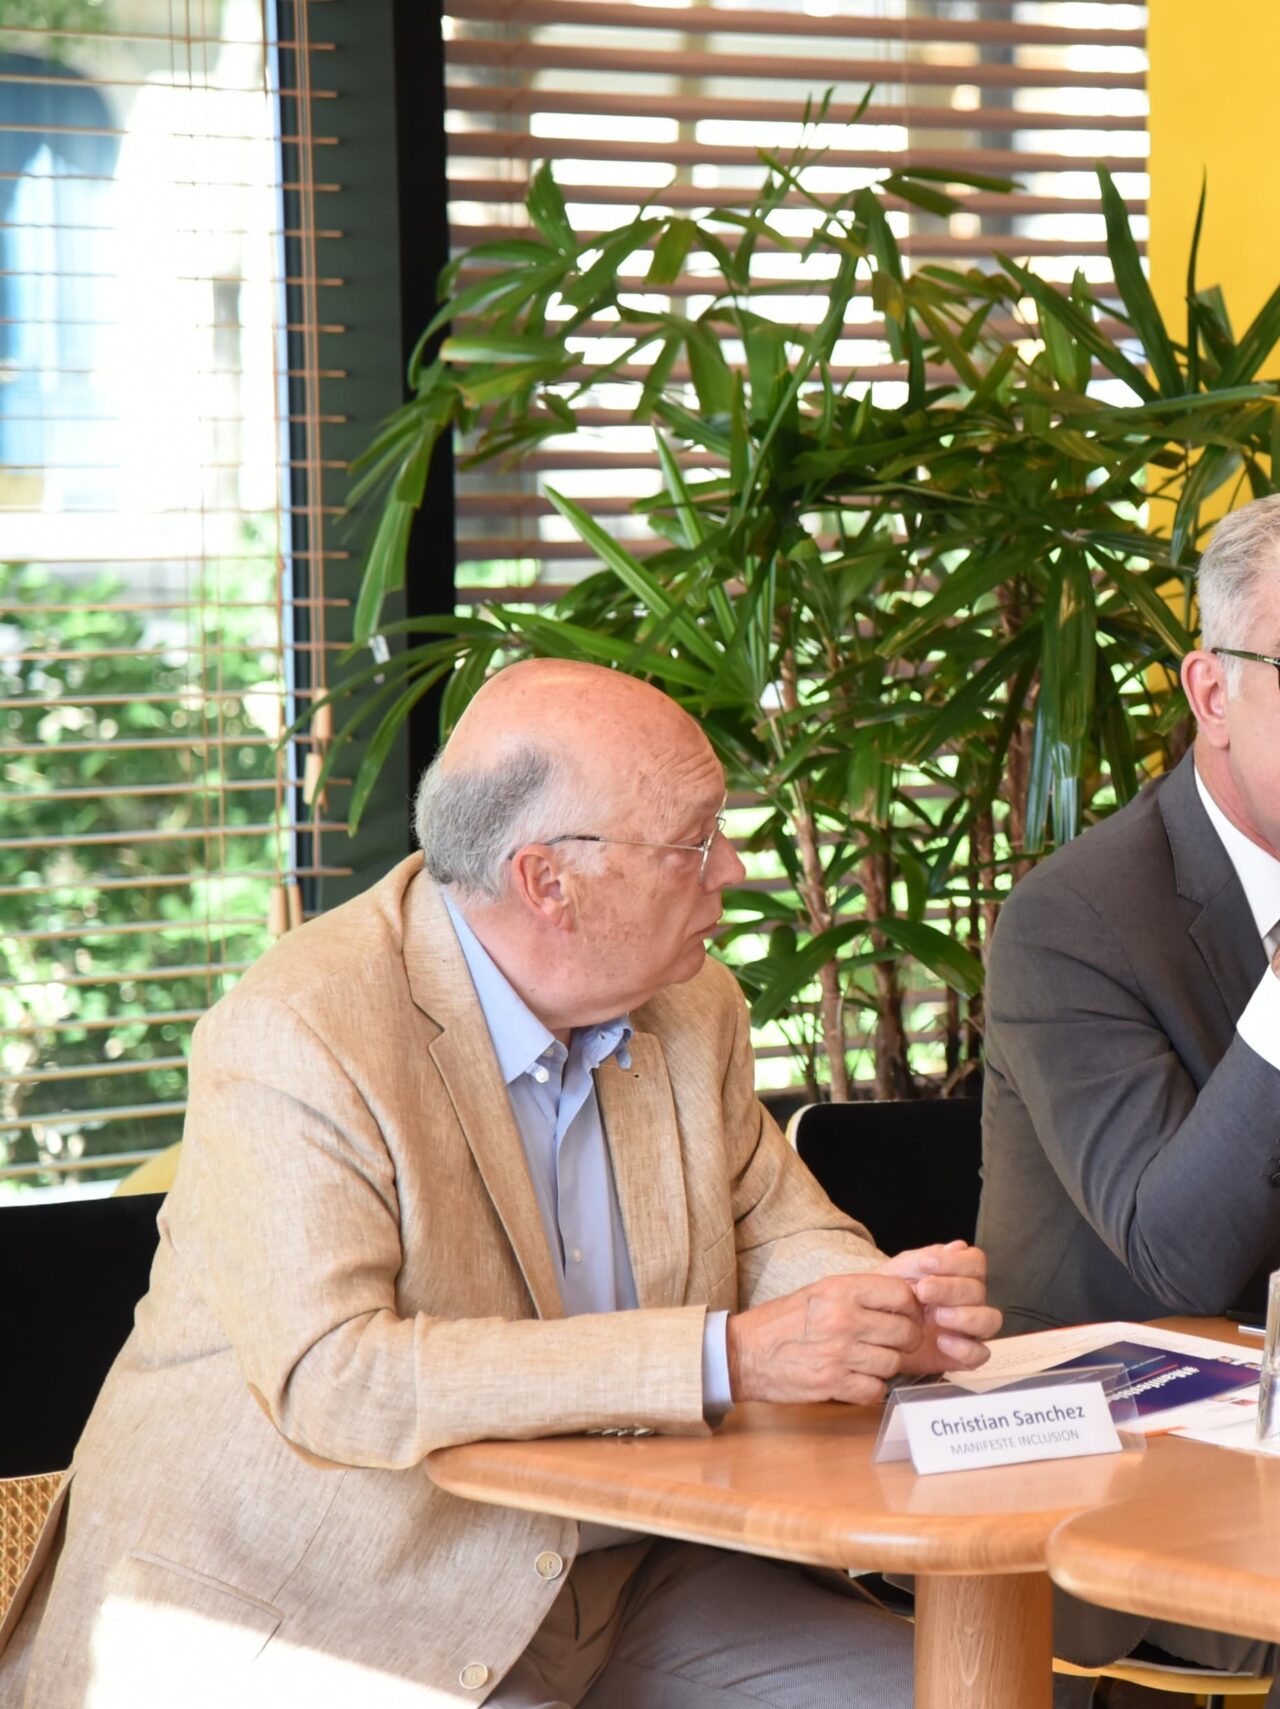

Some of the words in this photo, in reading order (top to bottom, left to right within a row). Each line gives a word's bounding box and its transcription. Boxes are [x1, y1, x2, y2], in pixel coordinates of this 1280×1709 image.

[931, 1414, 1010, 1437] Christian
[1013, 1405, 1085, 1427] Sanchez
[950, 1437, 1015, 1456] MANIFESTE
[1018, 1429, 1080, 1447] INCLUSION
